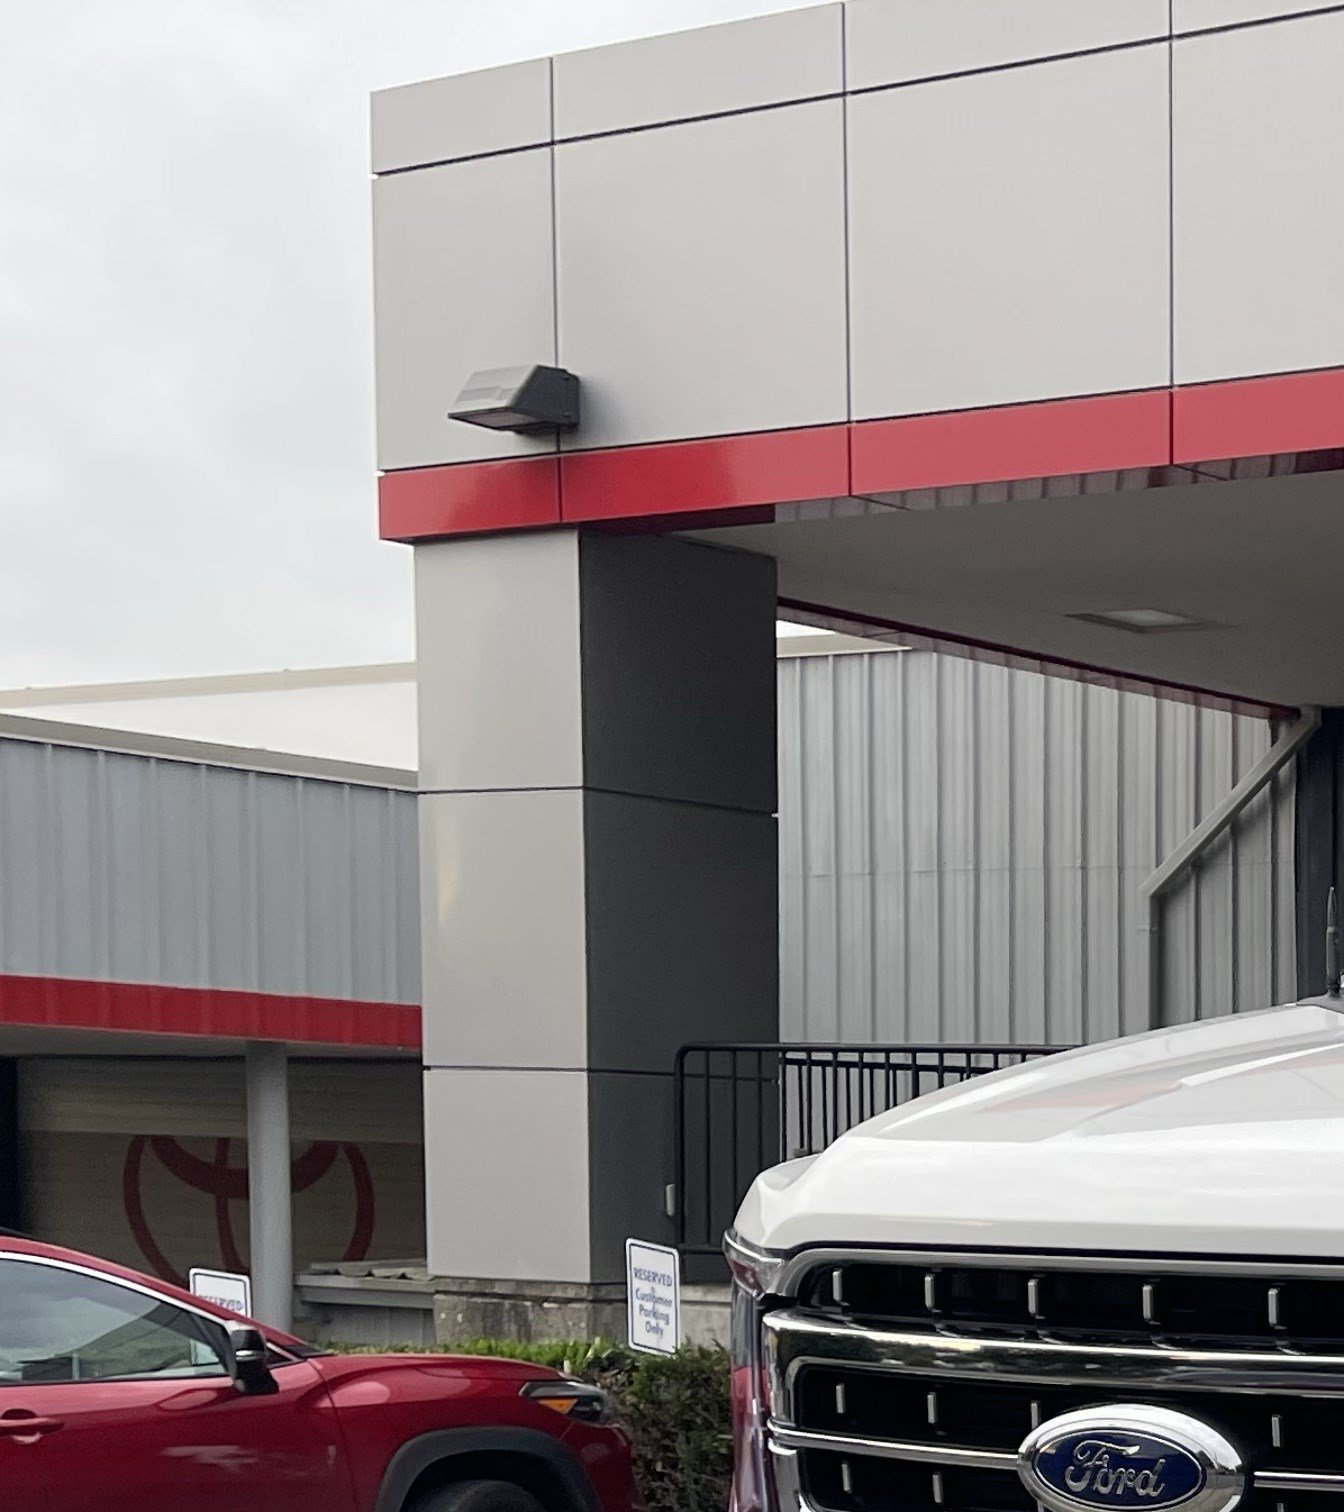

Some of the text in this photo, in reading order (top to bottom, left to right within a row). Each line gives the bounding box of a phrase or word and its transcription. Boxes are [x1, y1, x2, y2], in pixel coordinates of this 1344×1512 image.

[633, 1266, 672, 1287] RESERVED
[645, 1320, 663, 1338] Only
[1064, 1439, 1166, 1497] Ford
